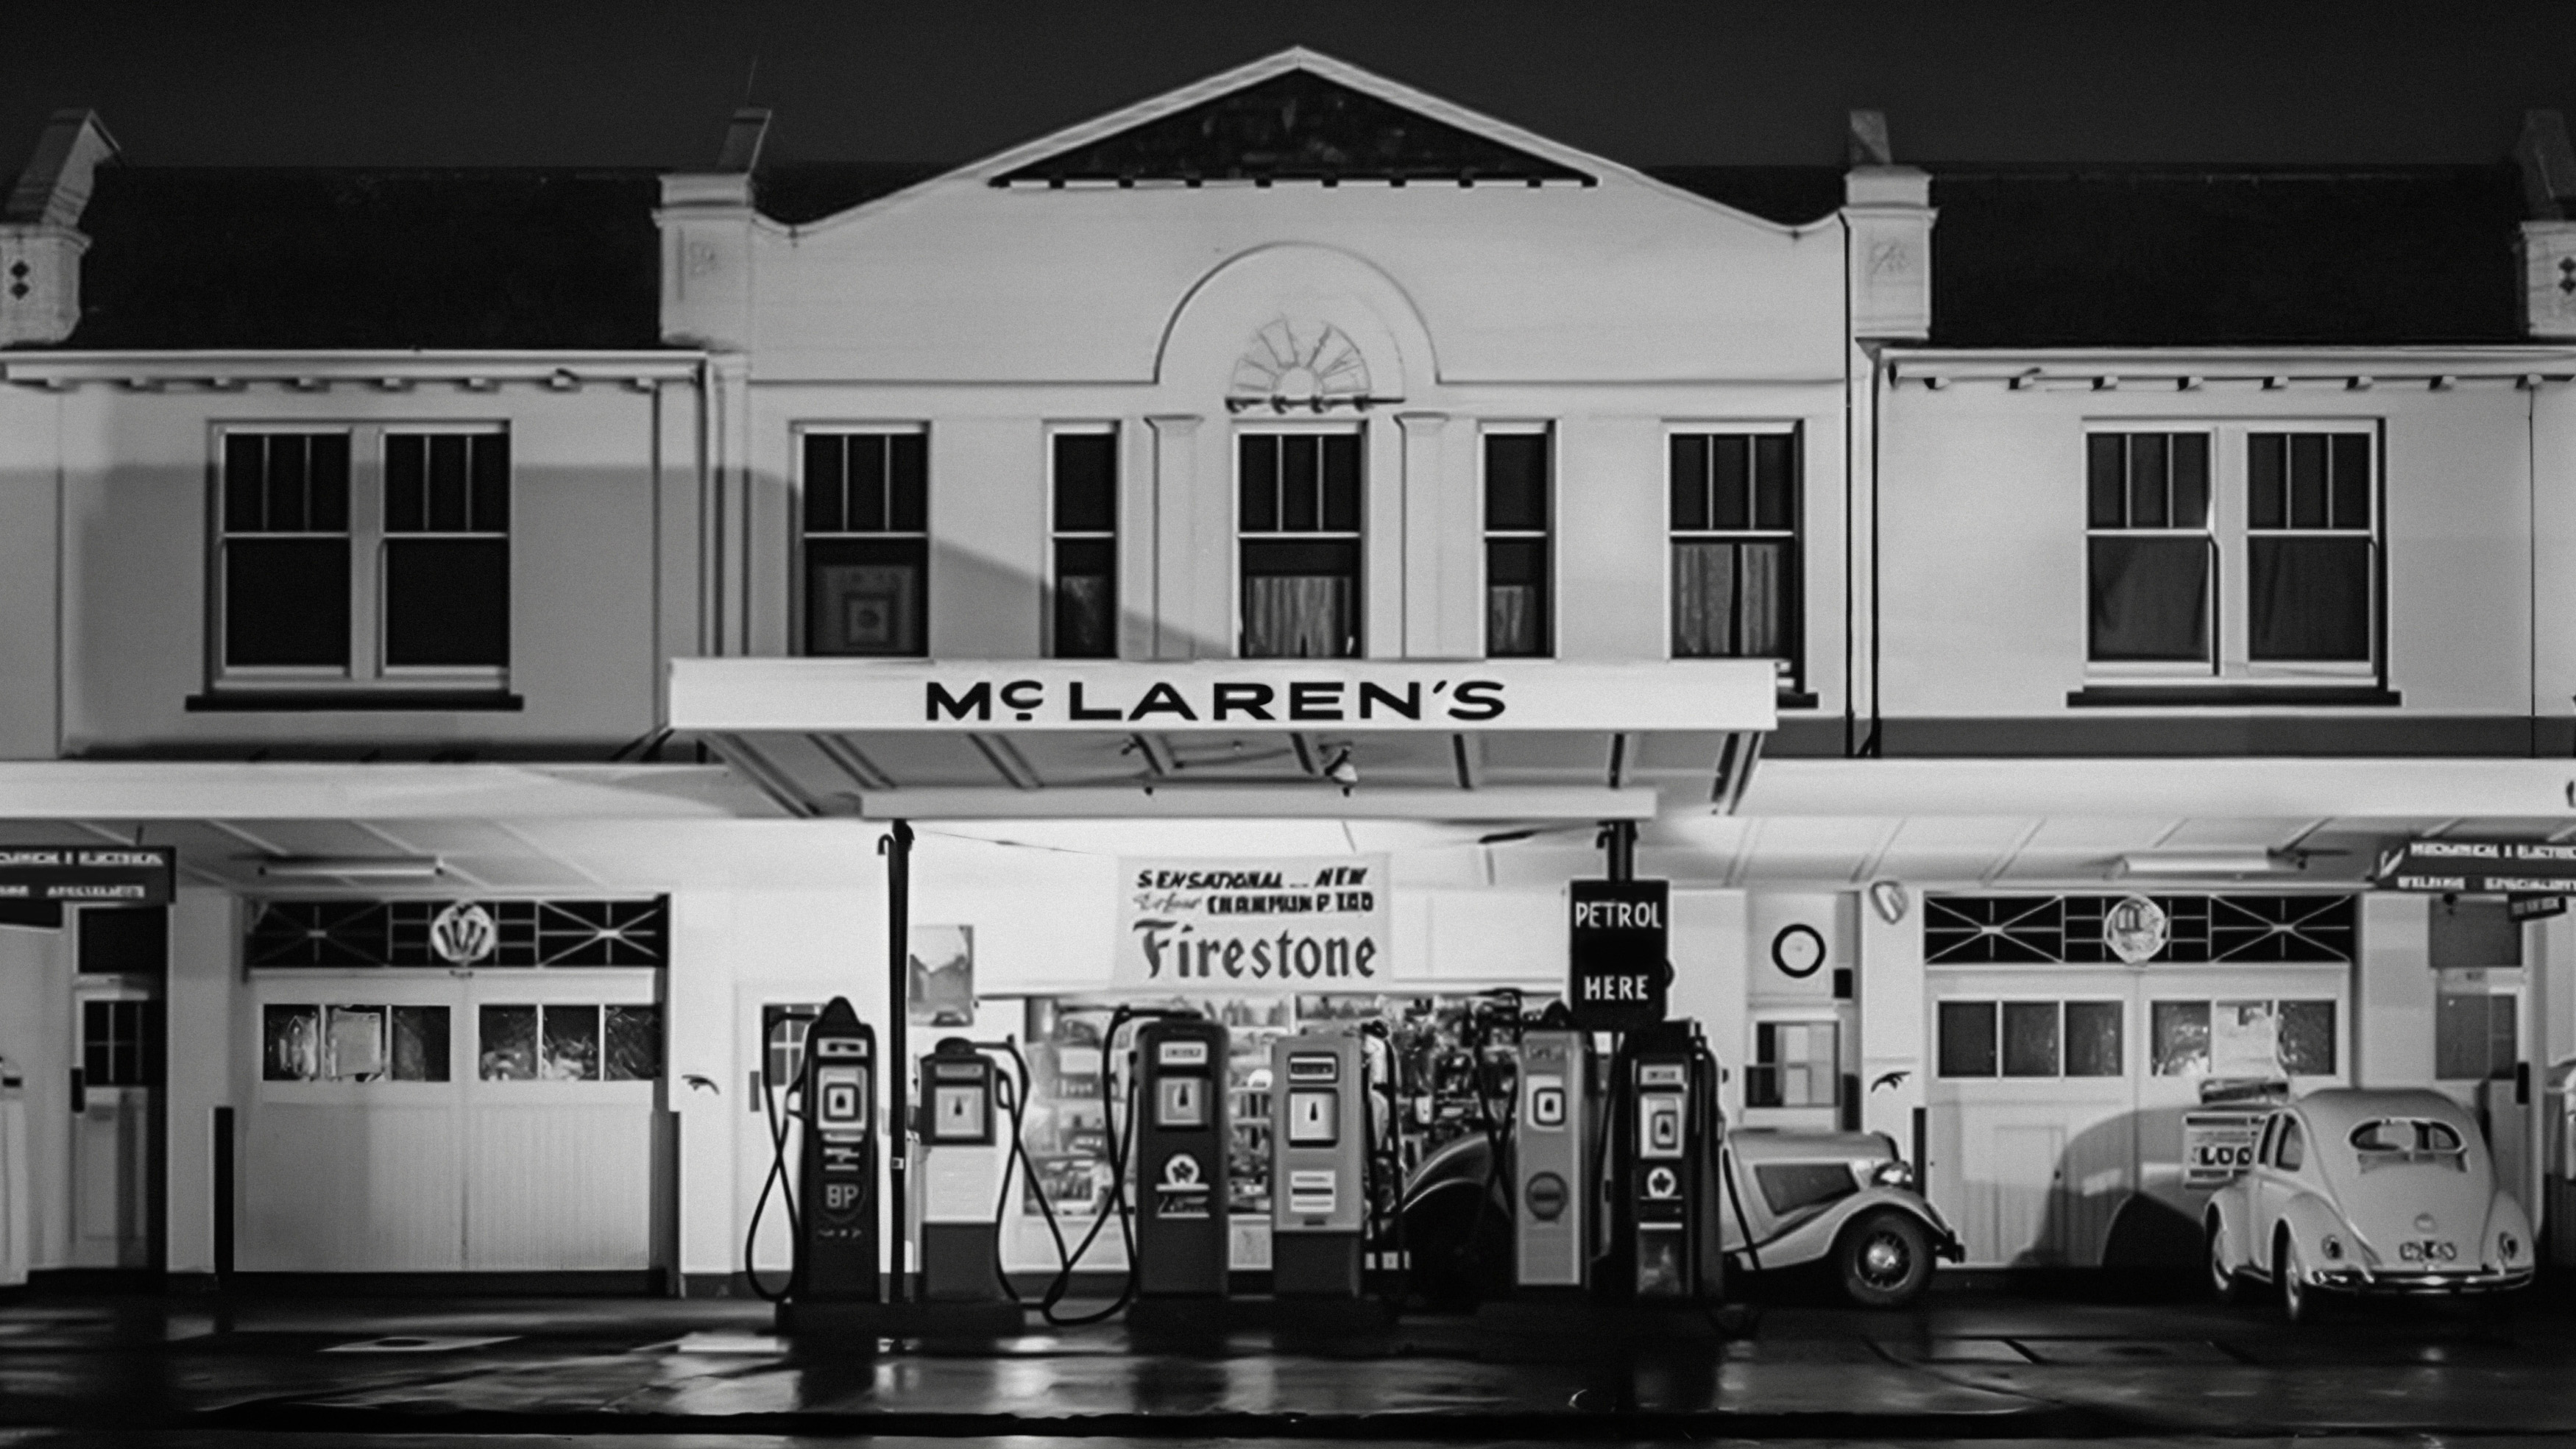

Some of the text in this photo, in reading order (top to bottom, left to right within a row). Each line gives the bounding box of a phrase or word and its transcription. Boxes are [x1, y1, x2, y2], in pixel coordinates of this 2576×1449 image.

[1315, 867, 1367, 887] NEW
[1575, 901, 1662, 928] PETROL
[1133, 918, 1376, 979] Firestone
[1584, 975, 1649, 1000] HERE
[826, 1184, 860, 1209] BP
